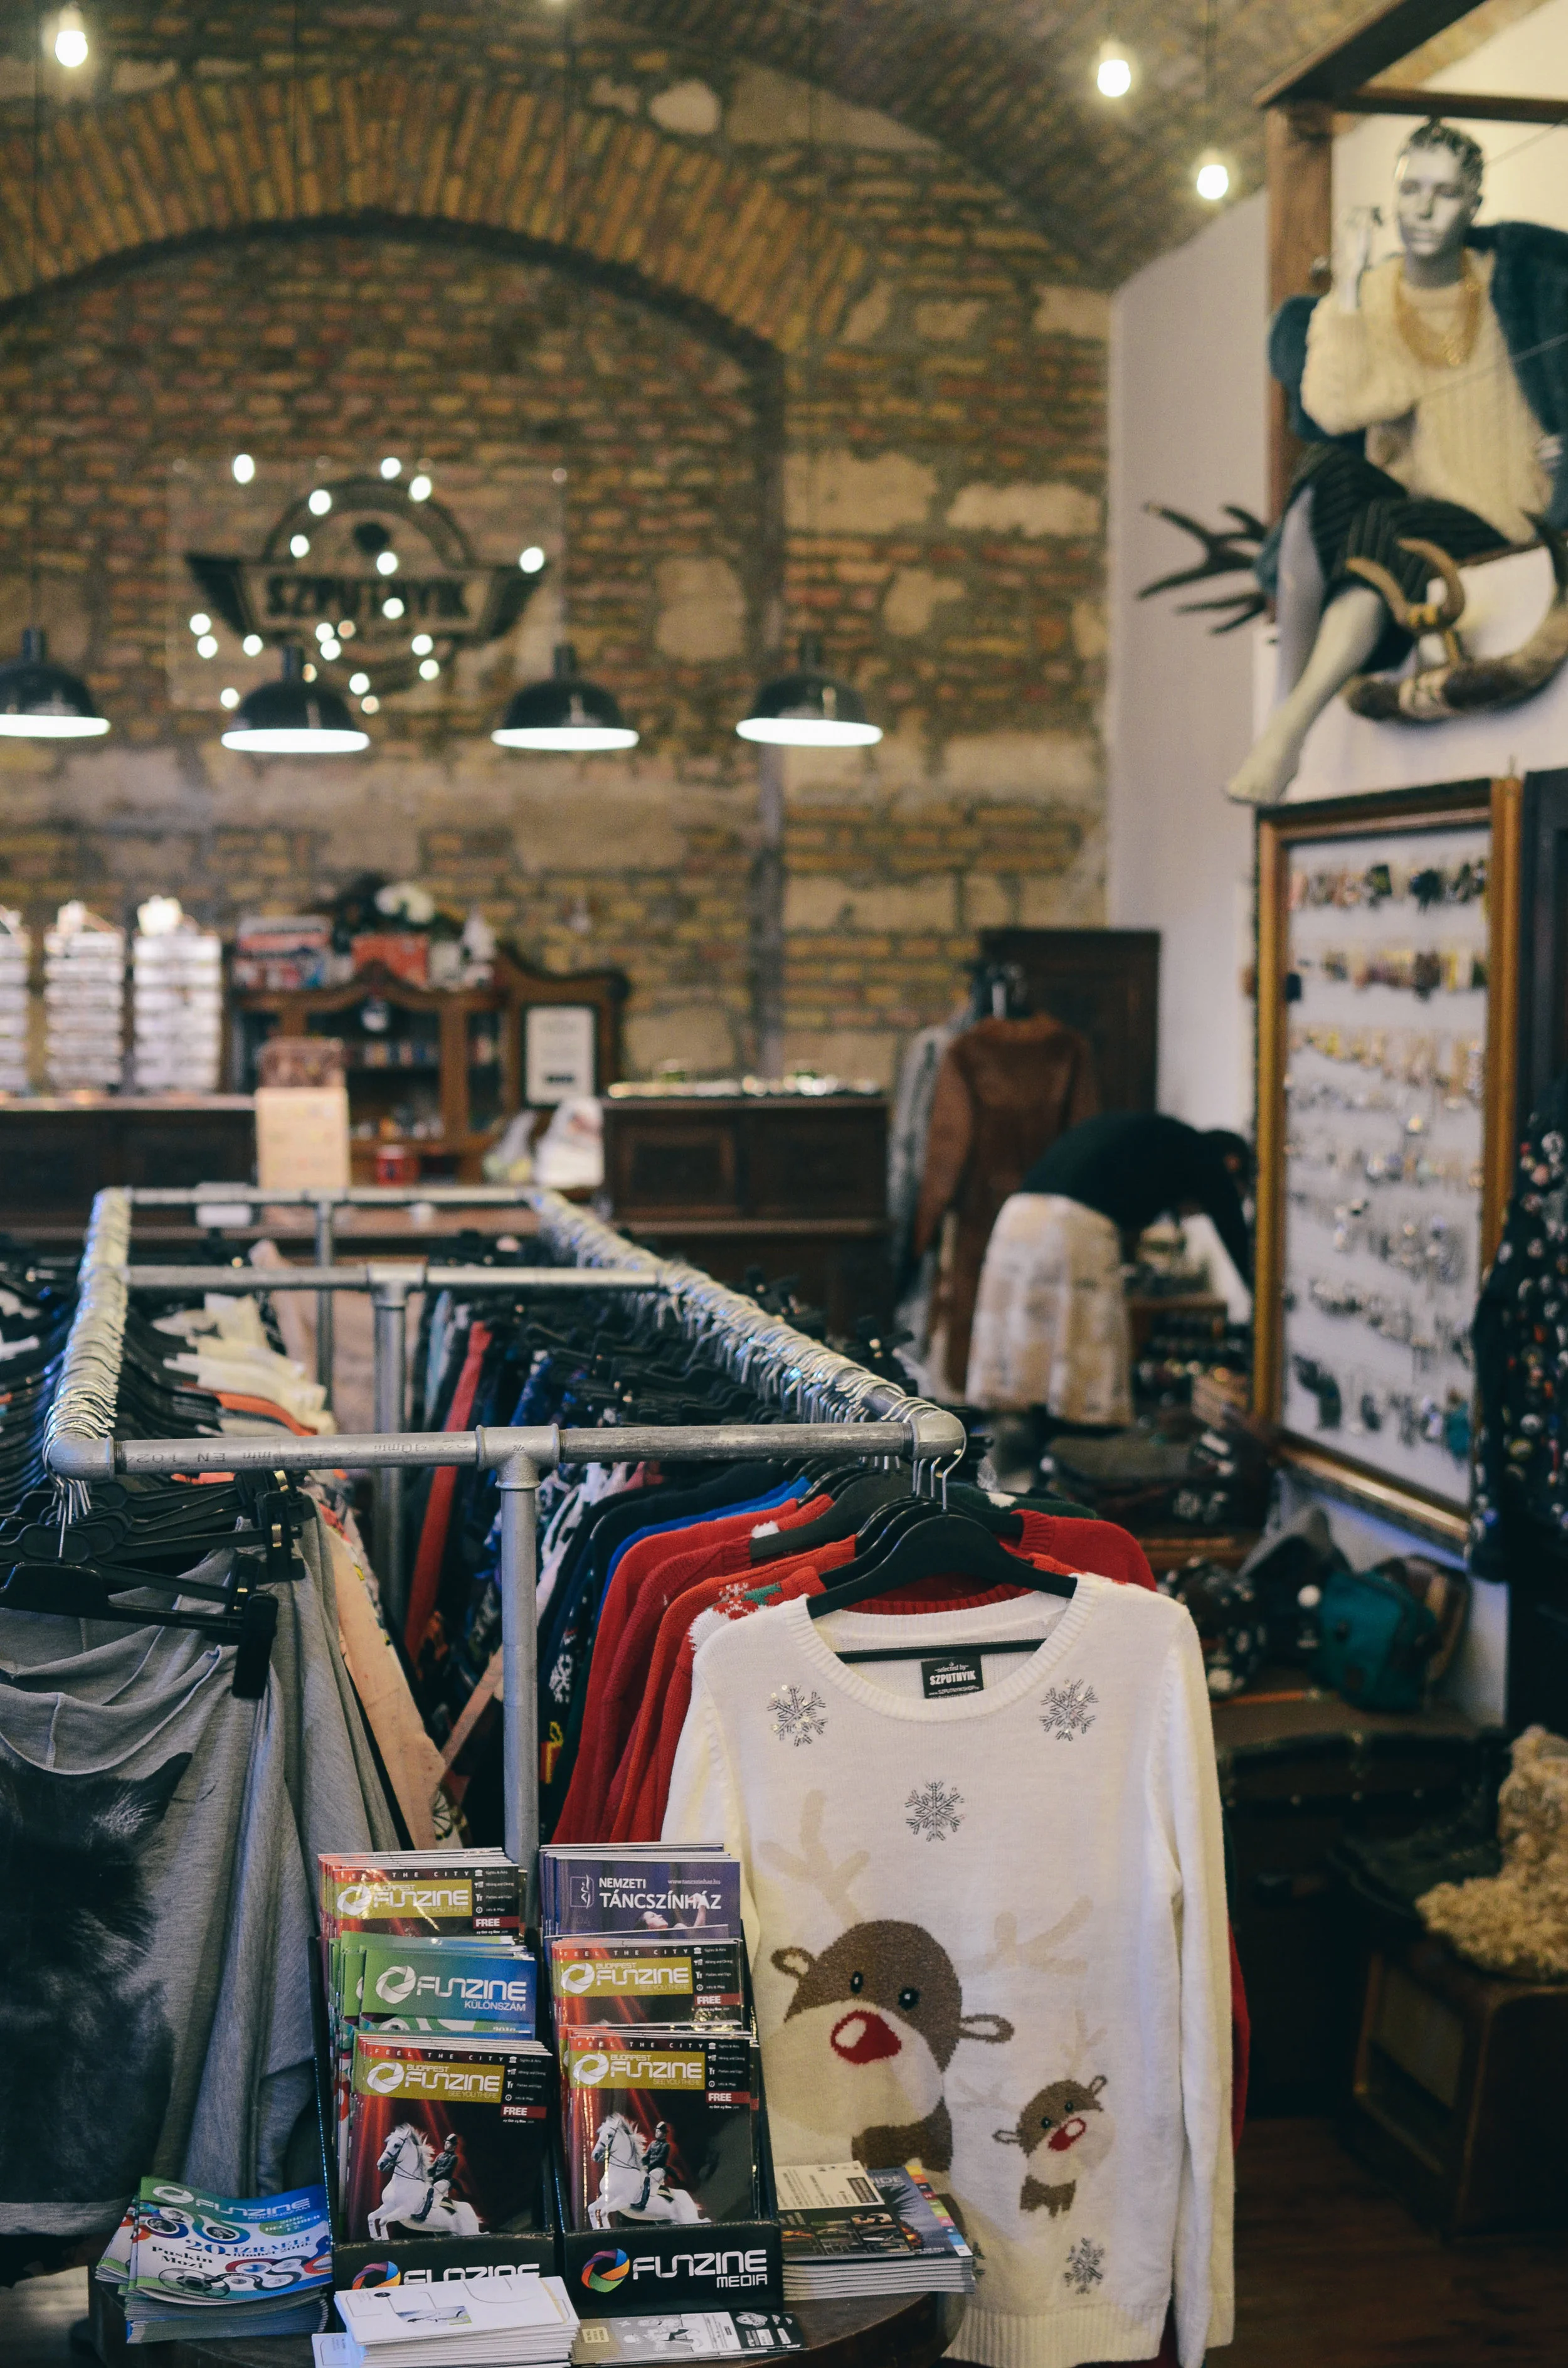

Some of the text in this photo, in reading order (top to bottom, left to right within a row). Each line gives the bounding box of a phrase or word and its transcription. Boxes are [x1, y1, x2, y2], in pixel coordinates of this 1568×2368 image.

[197, 1452, 226, 1463] EN
[930, 1670, 976, 1686] SZPUTNYIK
[599, 1877, 647, 1889] NEMZETI
[373, 1889, 469, 1908] FUNZINE
[599, 1889, 721, 1909] TÁNCSZÍNHÁZ
[475, 1918, 500, 1927] FREE
[597, 1967, 689, 1986] FUNZINE
[416, 1976, 527, 2001] FUNZINE
[465, 2000, 526, 2012] KÜLÖNSZÁM
[697, 1995, 721, 2004] FREE
[375, 2049, 412, 2057] FEEL
[611, 2061, 702, 2079] FUNZINE
[405, 2071, 500, 2091] FUNZINE
[708, 2093, 731, 2101] FREE
[503, 2106, 527, 2116] FREE
[152, 2246, 213, 2263] Puskin
[633, 2249, 766, 2280] FUNZINE
[716, 2273, 768, 2288] MEDIA
